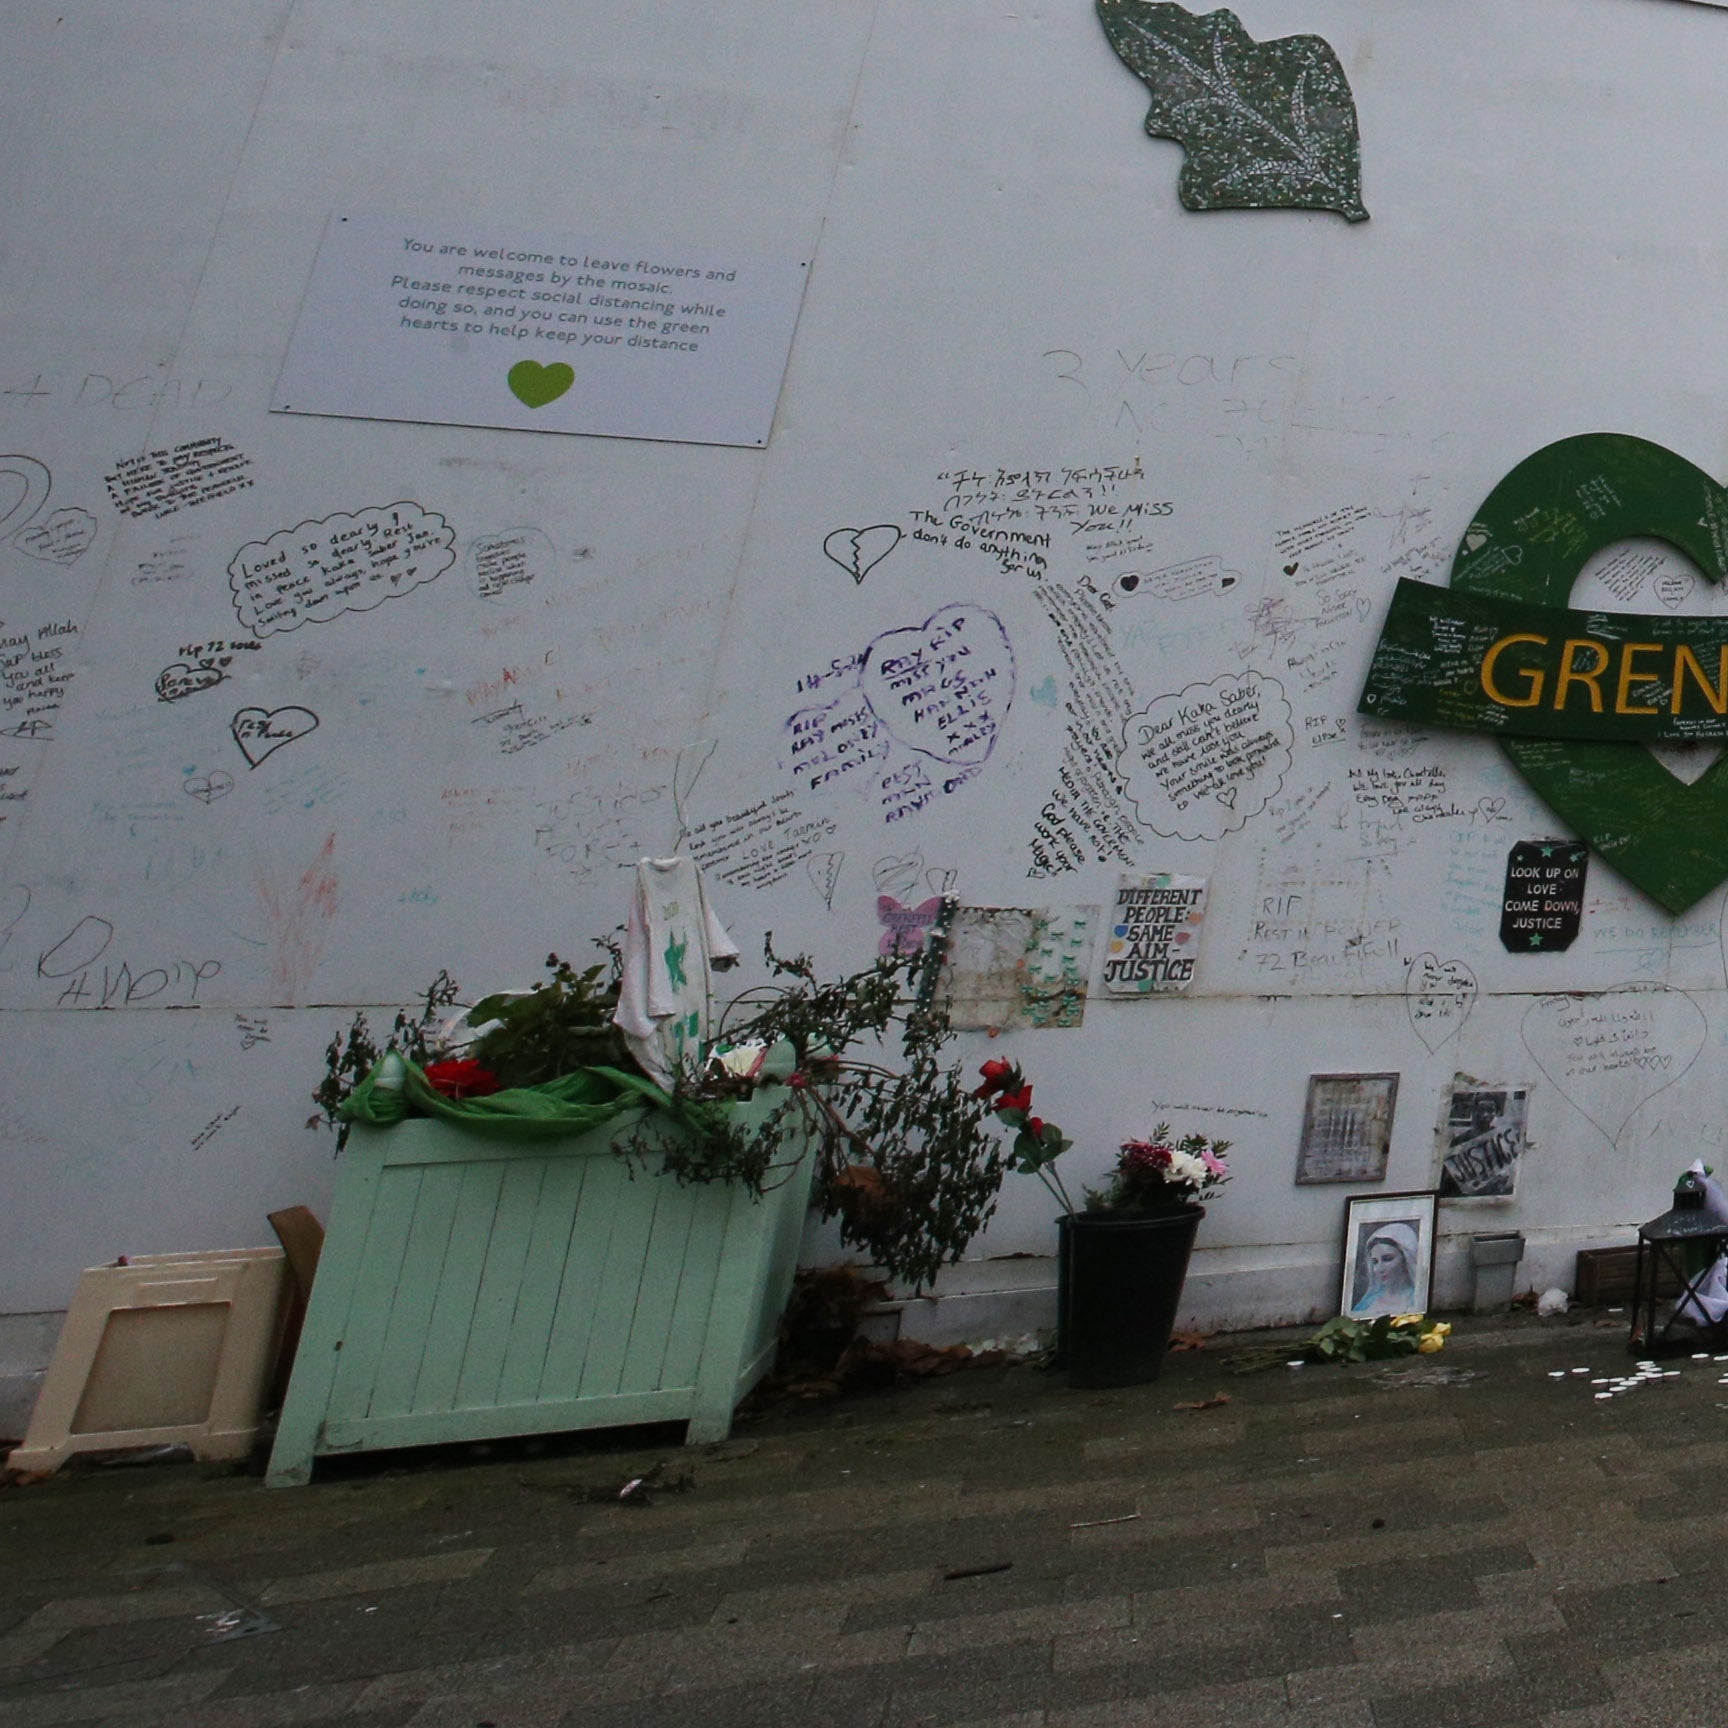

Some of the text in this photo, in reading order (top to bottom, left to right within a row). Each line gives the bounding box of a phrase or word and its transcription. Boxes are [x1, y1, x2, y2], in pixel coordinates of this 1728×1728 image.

[403, 237, 737, 282] You are welcome to leave flowers and
[391, 275, 727, 318] Please respect social distancing while
[458, 264, 674, 295] messages by the mosaic.
[398, 295, 711, 336] doing so, and you can use the green
[400, 315, 700, 352] hearts to help keep your distance
[1088, 502, 1121, 517] We
[909, 510, 1051, 549] The Government
[242, 522, 380, 579] Loved so dearly
[244, 567, 292, 591] missed
[306, 559, 321, 569] so
[383, 522, 415, 539] Rest
[912, 528, 1048, 570] don't do anything
[250, 592, 263, 602] in
[276, 575, 312, 596] peace
[254, 597, 284, 617] Love
[292, 588, 314, 605] you
[371, 554, 400, 569] hope
[305, 594, 330, 609] down
[334, 581, 361, 596] upon
[1138, 716, 1174, 746] Dear
[1177, 702, 1218, 727] Kaka
[1141, 701, 1261, 761] we all miss you dearly
[1147, 752, 1171, 770] and
[1192, 726, 1221, 747] can't
[1224, 712, 1260, 733] believe
[1155, 732, 1246, 778] we have you
[1189, 756, 1218, 776] smile
[1040, 802, 1087, 865] God please
[1511, 866, 1580, 879] LOOK UP ON
[1526, 883, 1558, 895] LOVE
[1117, 888, 1204, 906] DIFFERENT
[1505, 900, 1540, 912] COME
[1127, 924, 1176, 942] SAME
[1512, 917, 1563, 929] JUSTICE
[1103, 957, 1197, 983] JUSTICE
